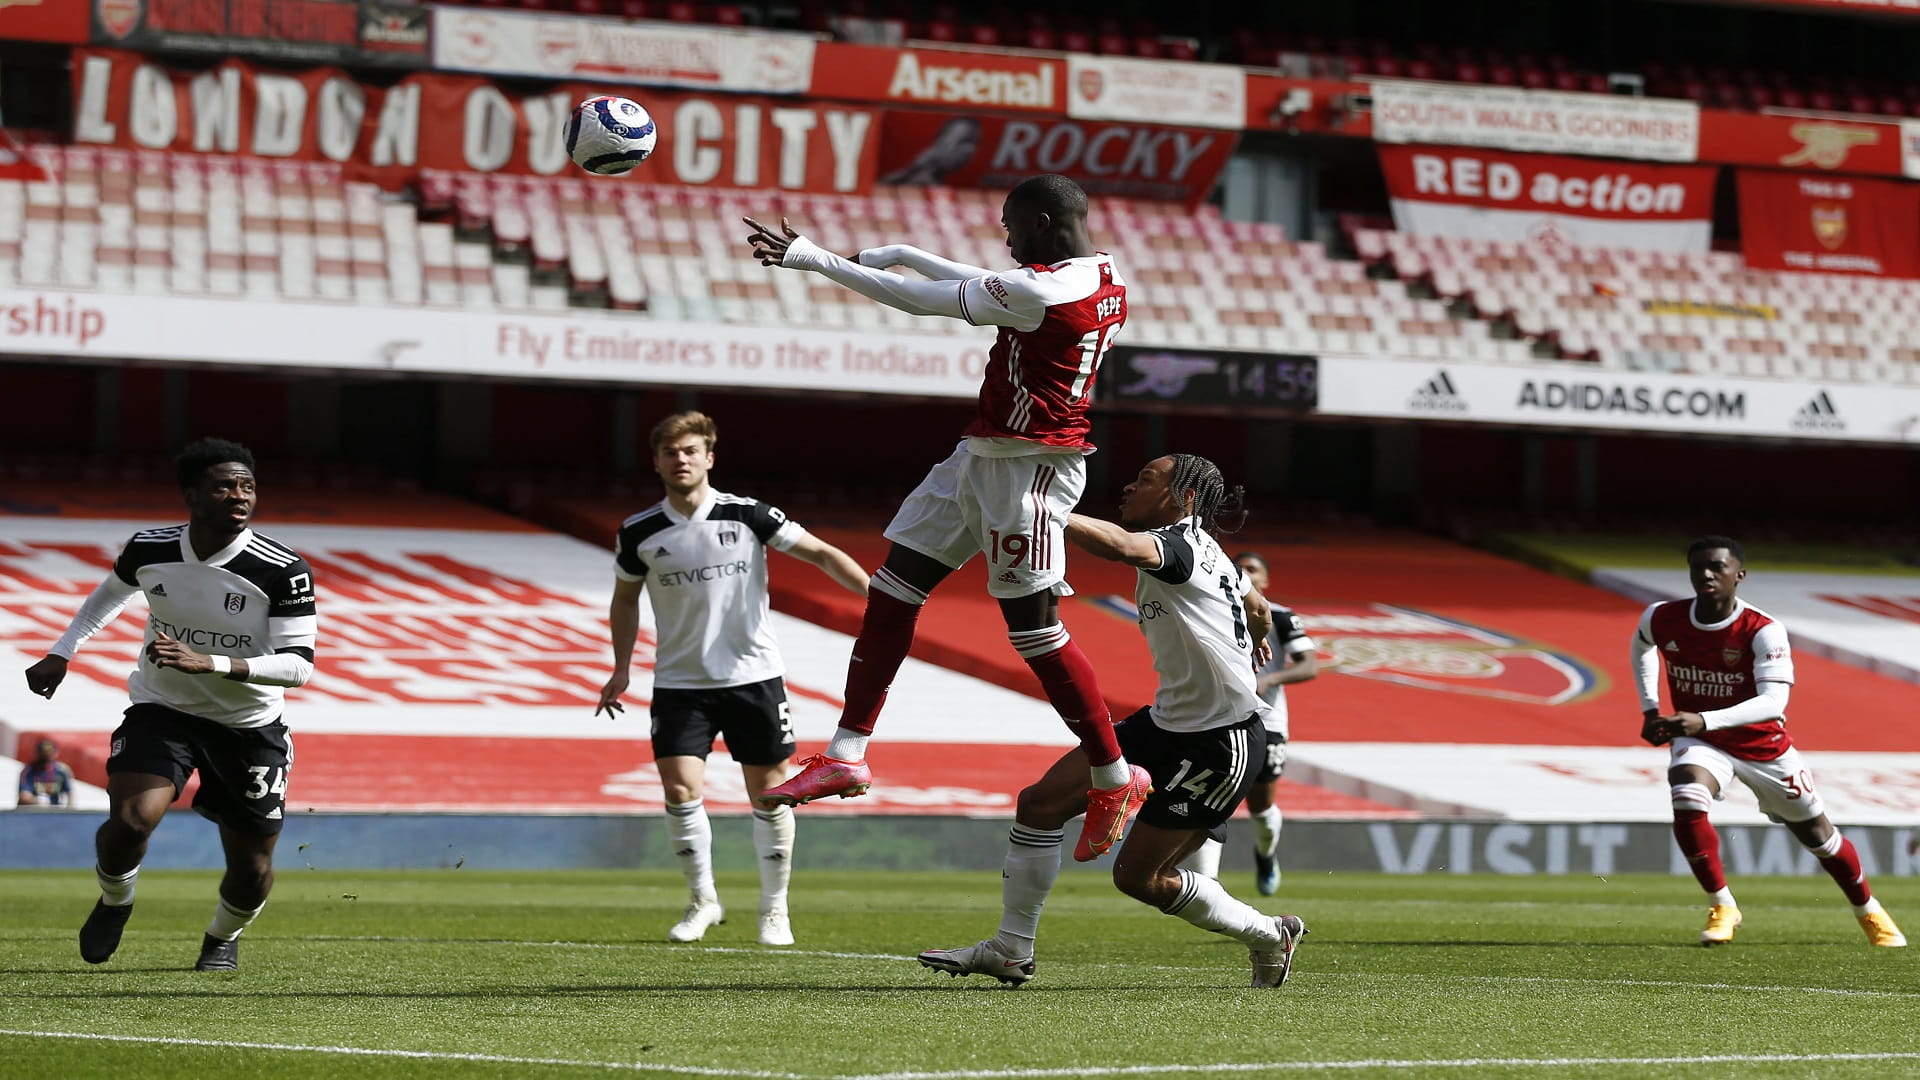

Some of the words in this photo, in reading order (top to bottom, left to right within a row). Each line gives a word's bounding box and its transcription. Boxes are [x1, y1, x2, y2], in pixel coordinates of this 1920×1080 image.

[889, 52, 1054, 107] Arsenal
[76, 56, 421, 166] LONDON
[463, 86, 632, 178] OU
[673, 99, 871, 192] CITY
[1380, 100, 1467, 130] SOUTH
[1475, 106, 1560, 134] WALES
[1567, 113, 1691, 141] GOONERS
[991, 120, 1214, 181] ROCKY
[1412, 153, 1522, 200] RED
[1529, 172, 1685, 213] action
[992, 276, 1008, 298] VISIT
[1096, 297, 1122, 322] PEPE
[496, 323, 553, 368] Fly
[564, 326, 716, 366] Emirates
[727, 339, 766, 369] to
[775, 339, 830, 373] the
[842, 340, 949, 377] Indian
[1518, 380, 1746, 421] ADIDAS.COM
[989, 529, 1030, 569] 19
[1666, 661, 1744, 685] Emirates
[1694, 682, 1733, 697] BETTER
[245, 766, 287, 800] 34
[1165, 759, 1214, 800] 14
[1781, 769, 1816, 800] 30
[1369, 824, 1627, 875] VISIT
